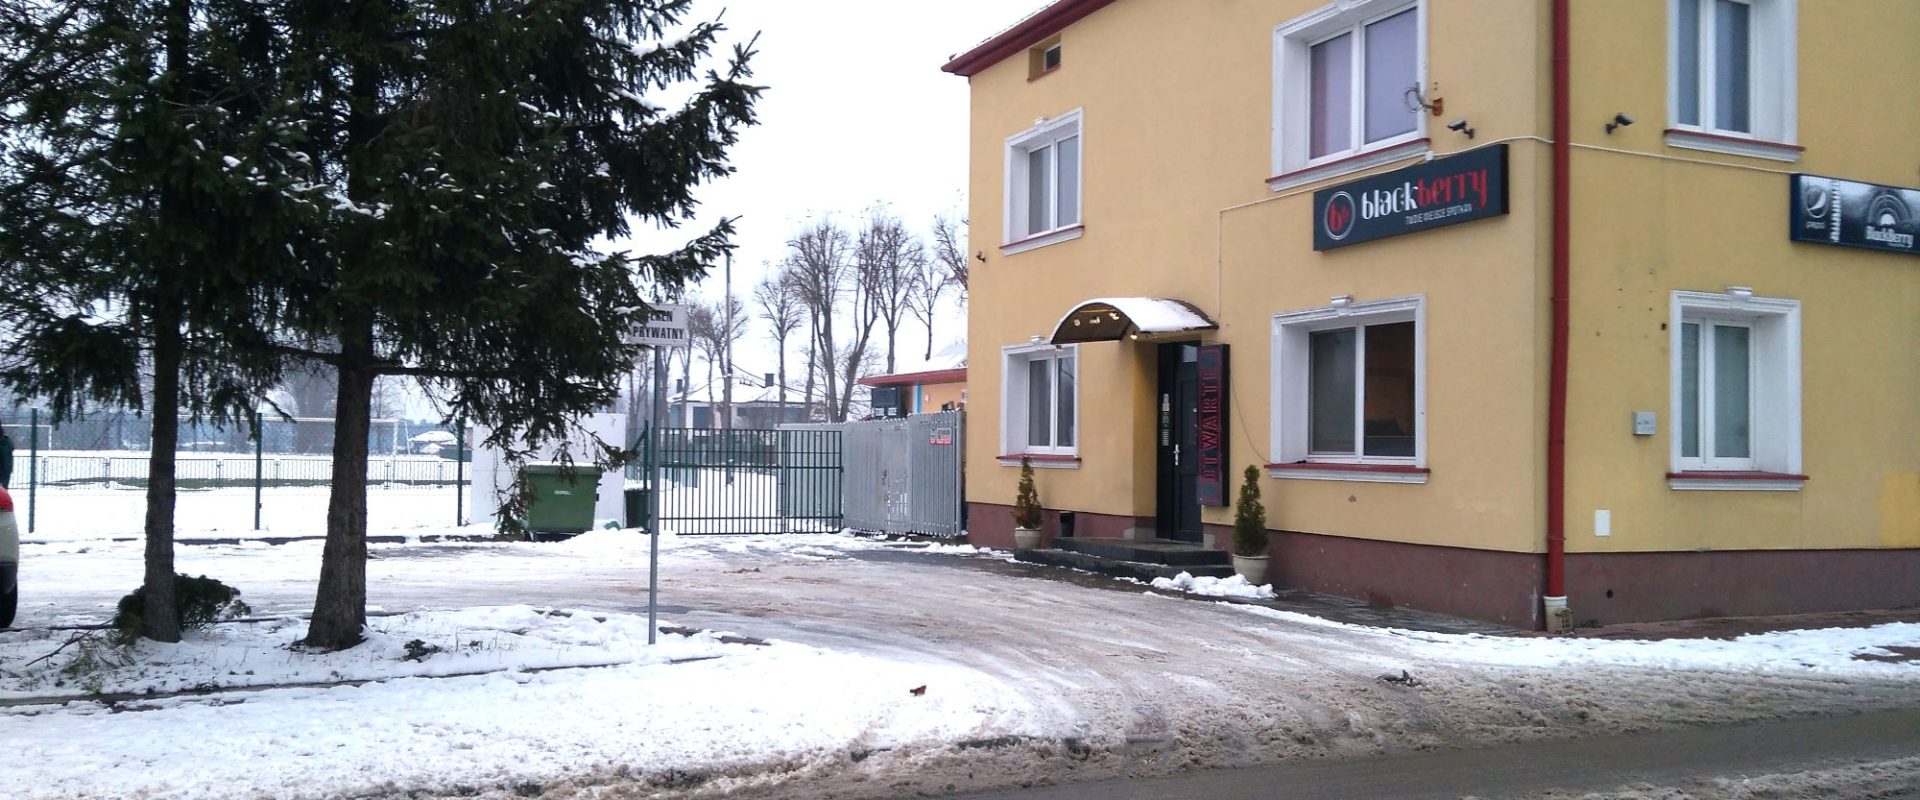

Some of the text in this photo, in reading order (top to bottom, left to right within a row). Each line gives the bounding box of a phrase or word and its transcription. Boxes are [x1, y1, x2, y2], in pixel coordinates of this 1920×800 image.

[1361, 168, 1488, 220] blackberry
[648, 310, 673, 322] EREN
[633, 326, 684, 340] PRYWATNY
